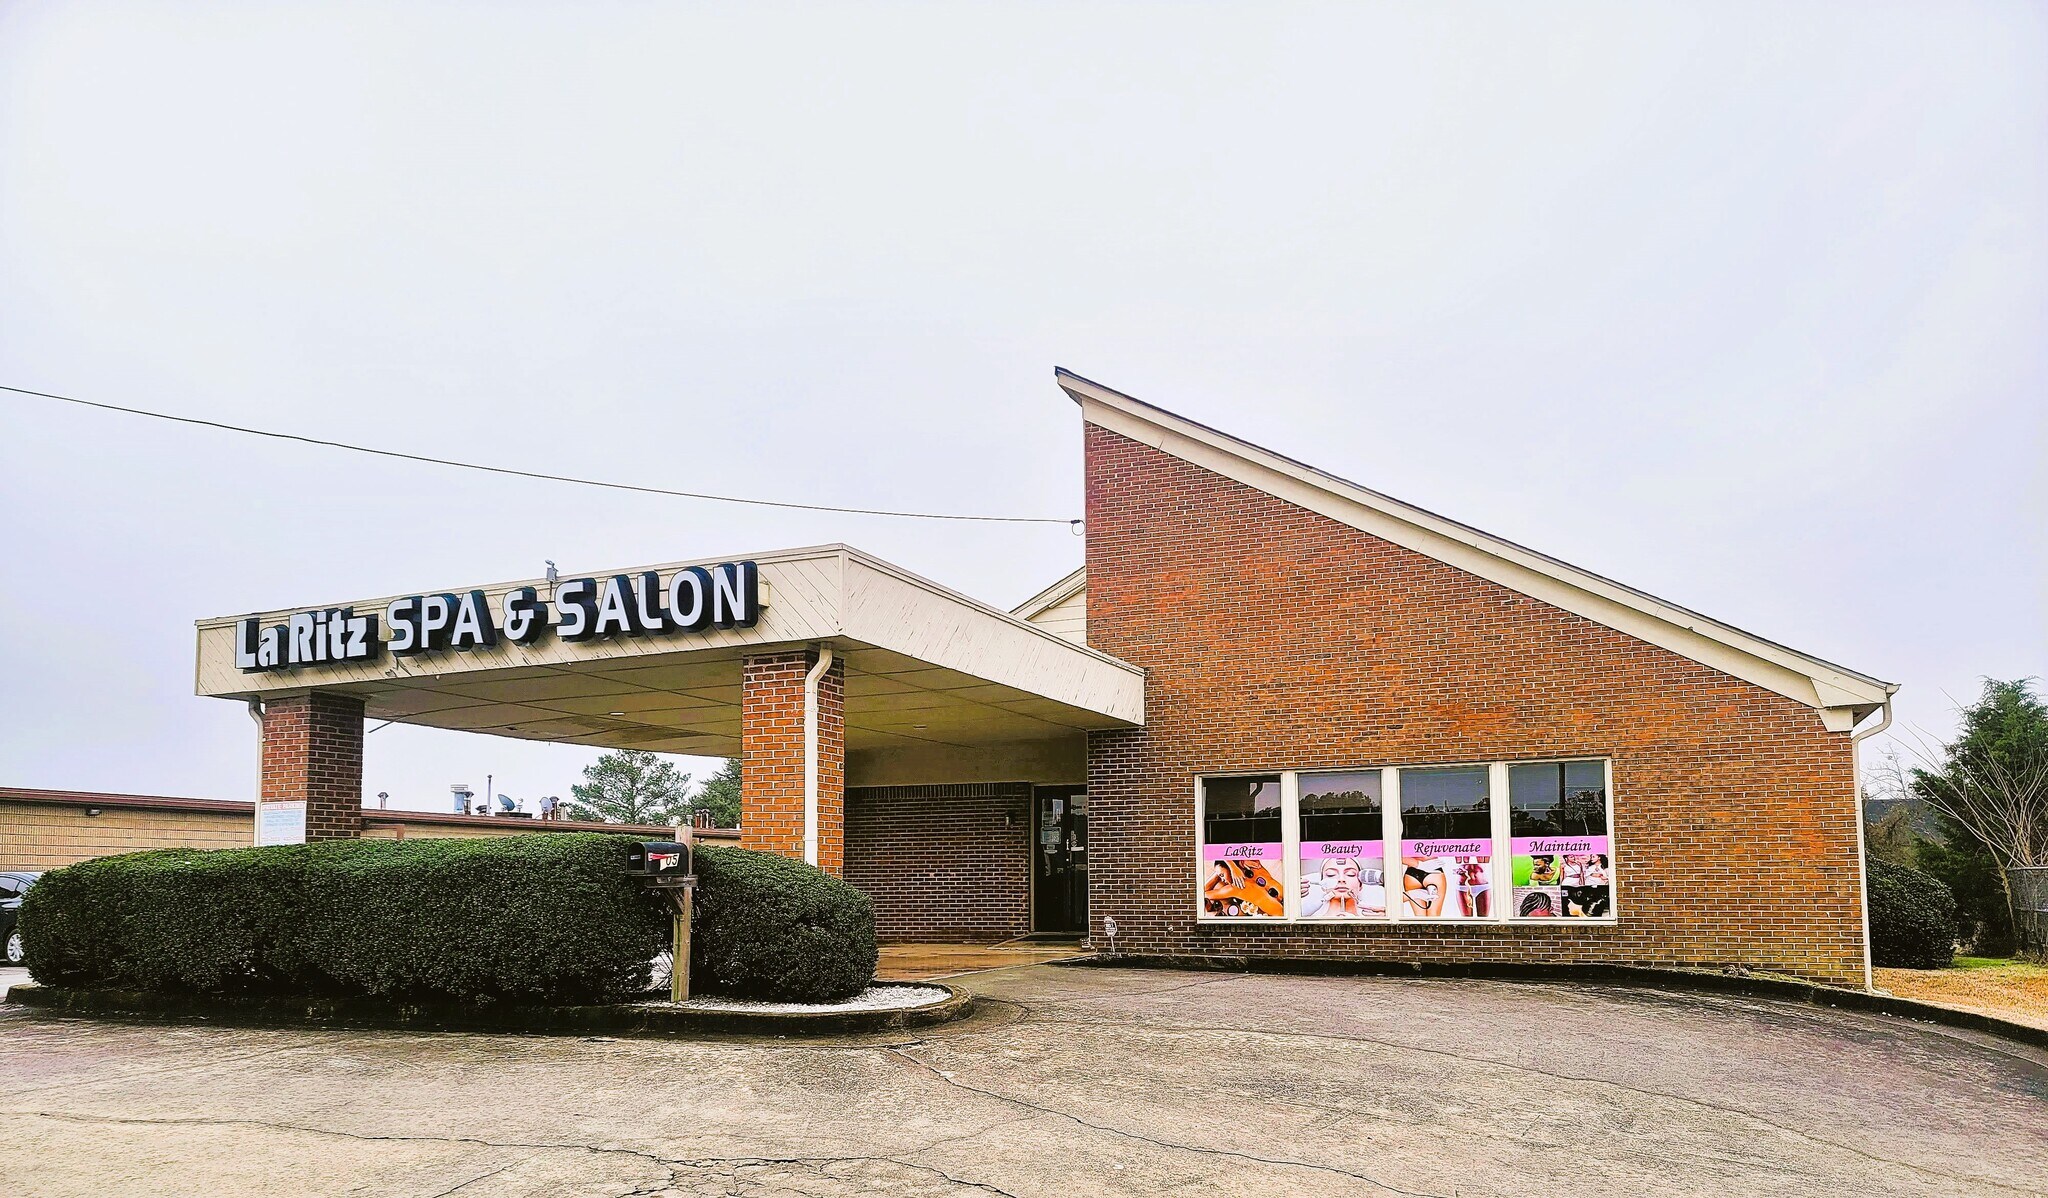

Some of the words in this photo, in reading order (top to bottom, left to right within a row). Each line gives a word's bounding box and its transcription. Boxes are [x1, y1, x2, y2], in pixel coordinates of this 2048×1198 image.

[235, 620, 281, 670] La
[288, 609, 368, 664] Ritz
[386, 592, 486, 652] SPA
[502, 589, 537, 642] &
[554, 563, 746, 638] SALON
[1223, 845, 1264, 859] LaRitz
[1320, 843, 1363, 858] Beauty
[1413, 841, 1482, 857] Rejuvenate
[1528, 839, 1592, 853] Maintain
